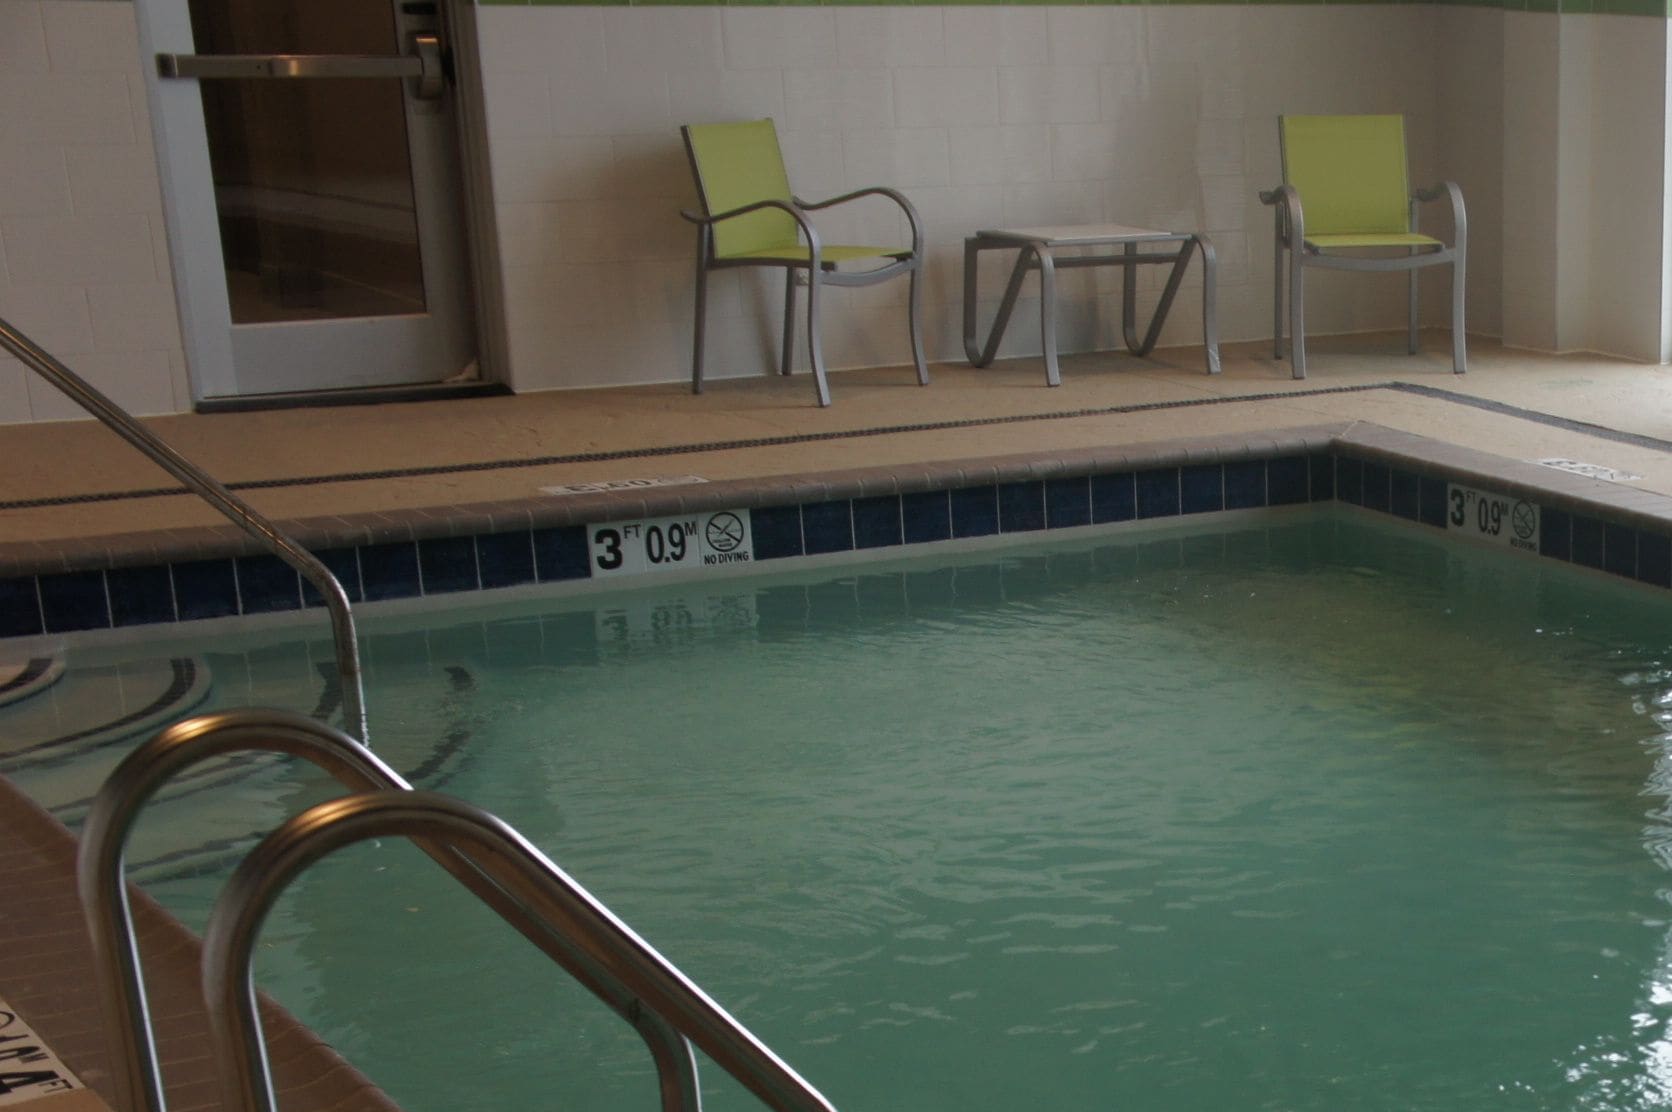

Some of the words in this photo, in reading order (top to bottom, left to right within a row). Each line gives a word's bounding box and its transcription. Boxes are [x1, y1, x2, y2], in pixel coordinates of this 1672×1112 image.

[1450, 488, 1465, 528] 3
[1478, 497, 1501, 536] 0.9
[594, 528, 623, 571] 3
[623, 523, 642, 540] FT
[646, 522, 687, 565] 0.9
[685, 520, 697, 537] M
[704, 552, 717, 565] NO
[718, 551, 750, 564] DIVING
[38, 1079, 73, 1094] FT
